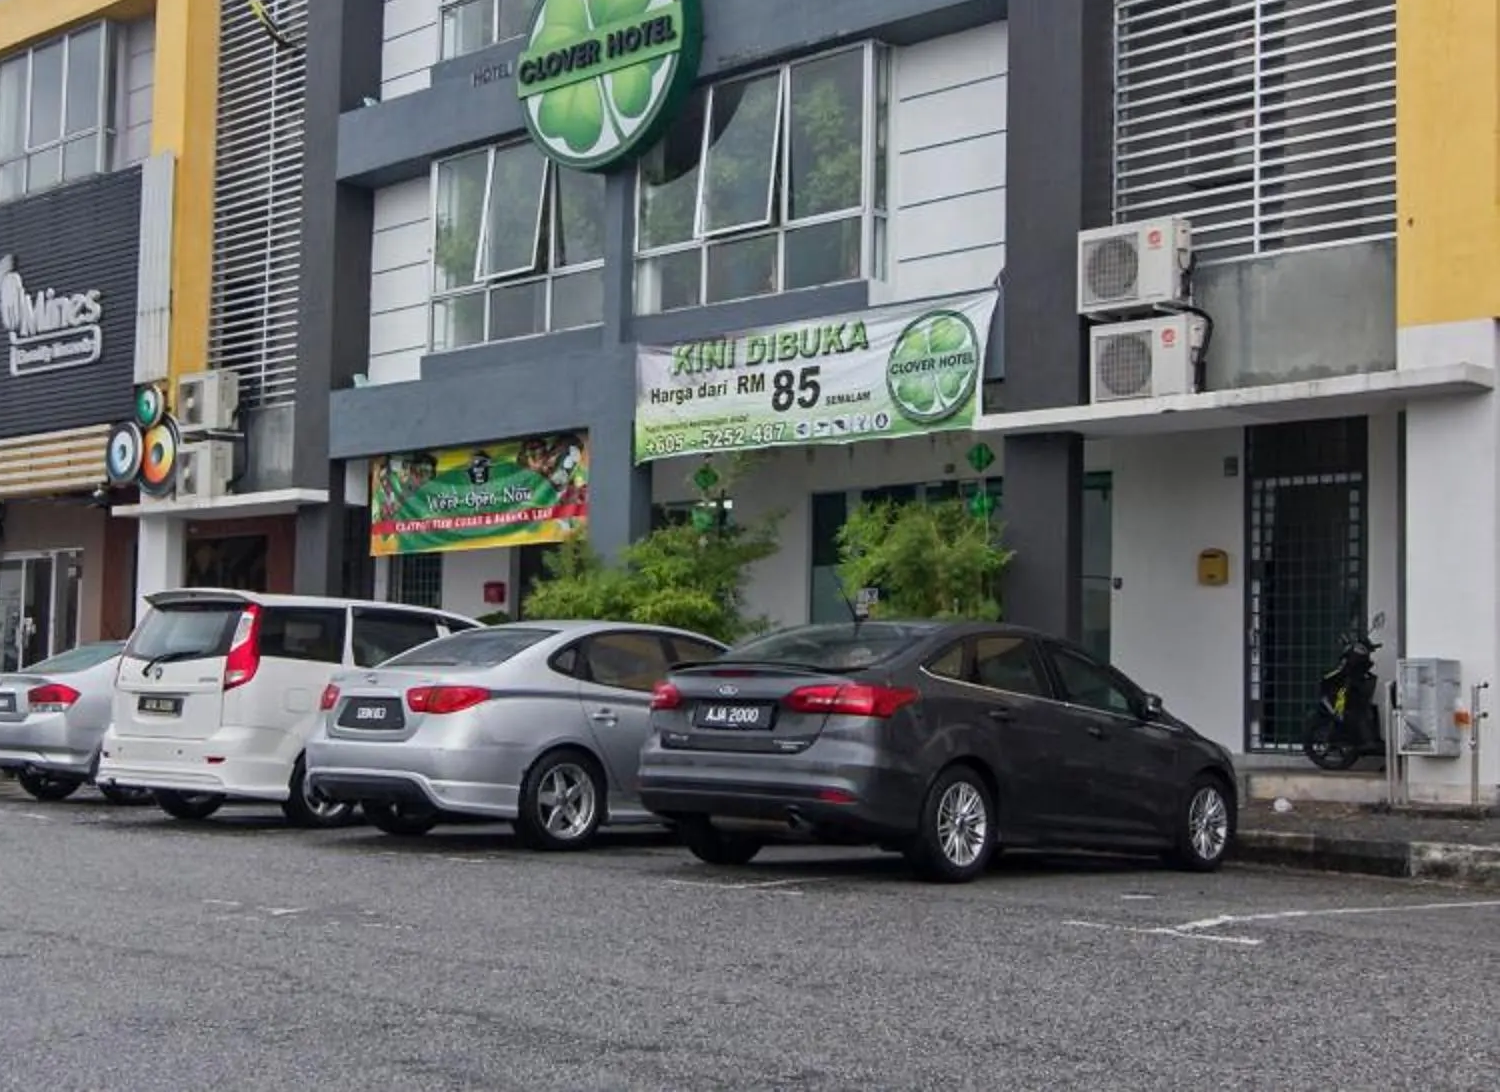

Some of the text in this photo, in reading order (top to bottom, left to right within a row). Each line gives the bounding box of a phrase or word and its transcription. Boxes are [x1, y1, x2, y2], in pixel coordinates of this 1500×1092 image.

[519, 14, 678, 86] CLOVER HOTEL
[472, 61, 512, 88] HOTEL
[20, 286, 101, 336] Mines
[672, 321, 870, 376] KINI DIBUKA
[890, 351, 975, 375] CLOVER HOTEL
[650, 365, 871, 412] Harga dari RM 85 SEMALAM
[702, 427, 746, 449] 5252
[705, 707, 760, 723] AJA 2000
